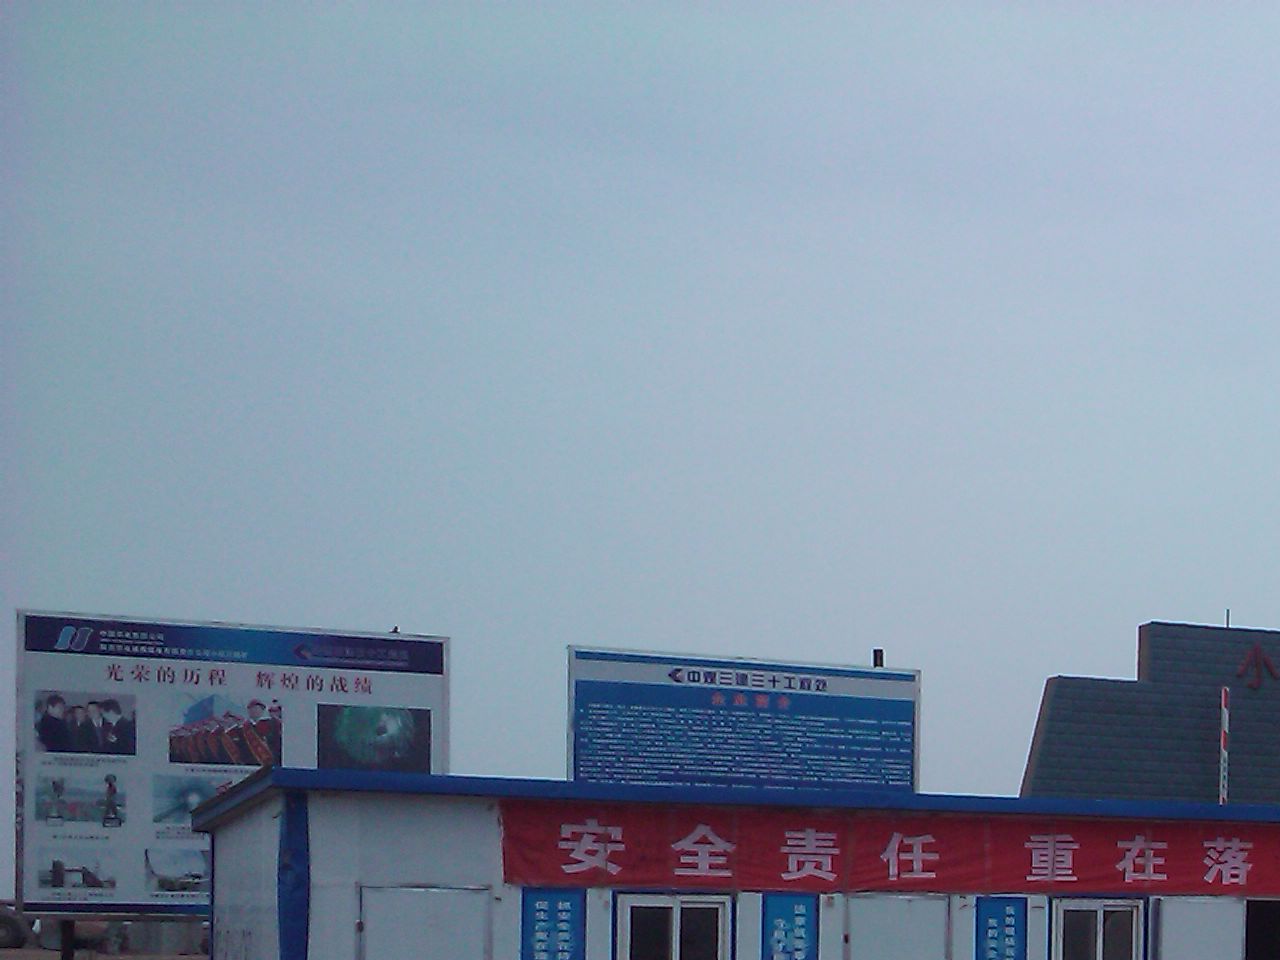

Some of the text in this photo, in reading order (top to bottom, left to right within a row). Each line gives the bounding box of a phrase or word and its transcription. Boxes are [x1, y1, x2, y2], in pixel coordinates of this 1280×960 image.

[104, 664, 373, 695] 光荣的历程 辉煌的战绩
[557, 818, 940, 881] 安全责任
